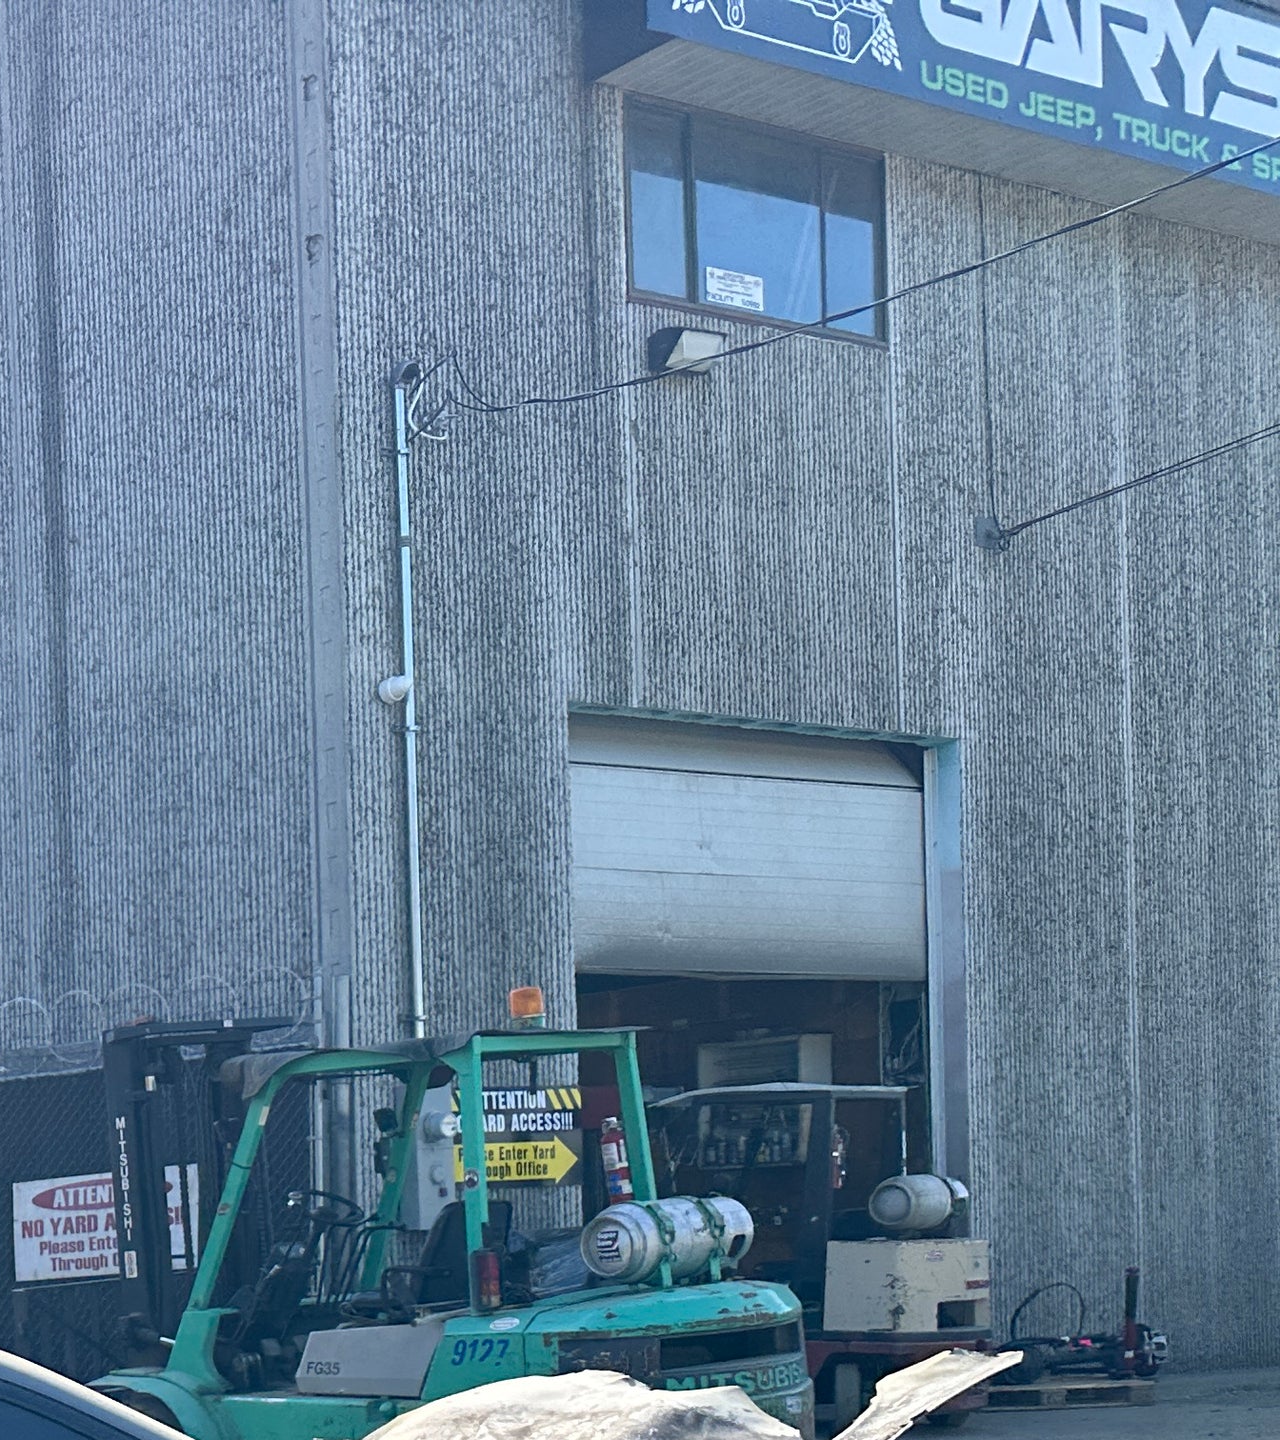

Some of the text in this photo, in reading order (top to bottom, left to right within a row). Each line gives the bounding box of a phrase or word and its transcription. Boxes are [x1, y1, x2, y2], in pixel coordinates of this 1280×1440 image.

[920, 59, 1009, 109] USED
[1019, 91, 1103, 141] JEEP,
[1112, 112, 1210, 163] TRUCK
[481, 1089, 547, 1110] TTENTION
[511, 1112, 574, 1133] ACCESS!!!
[499, 1146, 528, 1161] Enter
[532, 1145, 556, 1160] Yard
[115, 1116, 132, 1241] MITSUBISHI
[485, 1161, 549, 1179] ough Office
[21, 1219, 44, 1239] NO
[50, 1214, 99, 1237] YARD
[40, 1236, 118, 1256] Please Ente
[51, 1254, 109, 1272] Through
[306, 1361, 340, 1376] FG35
